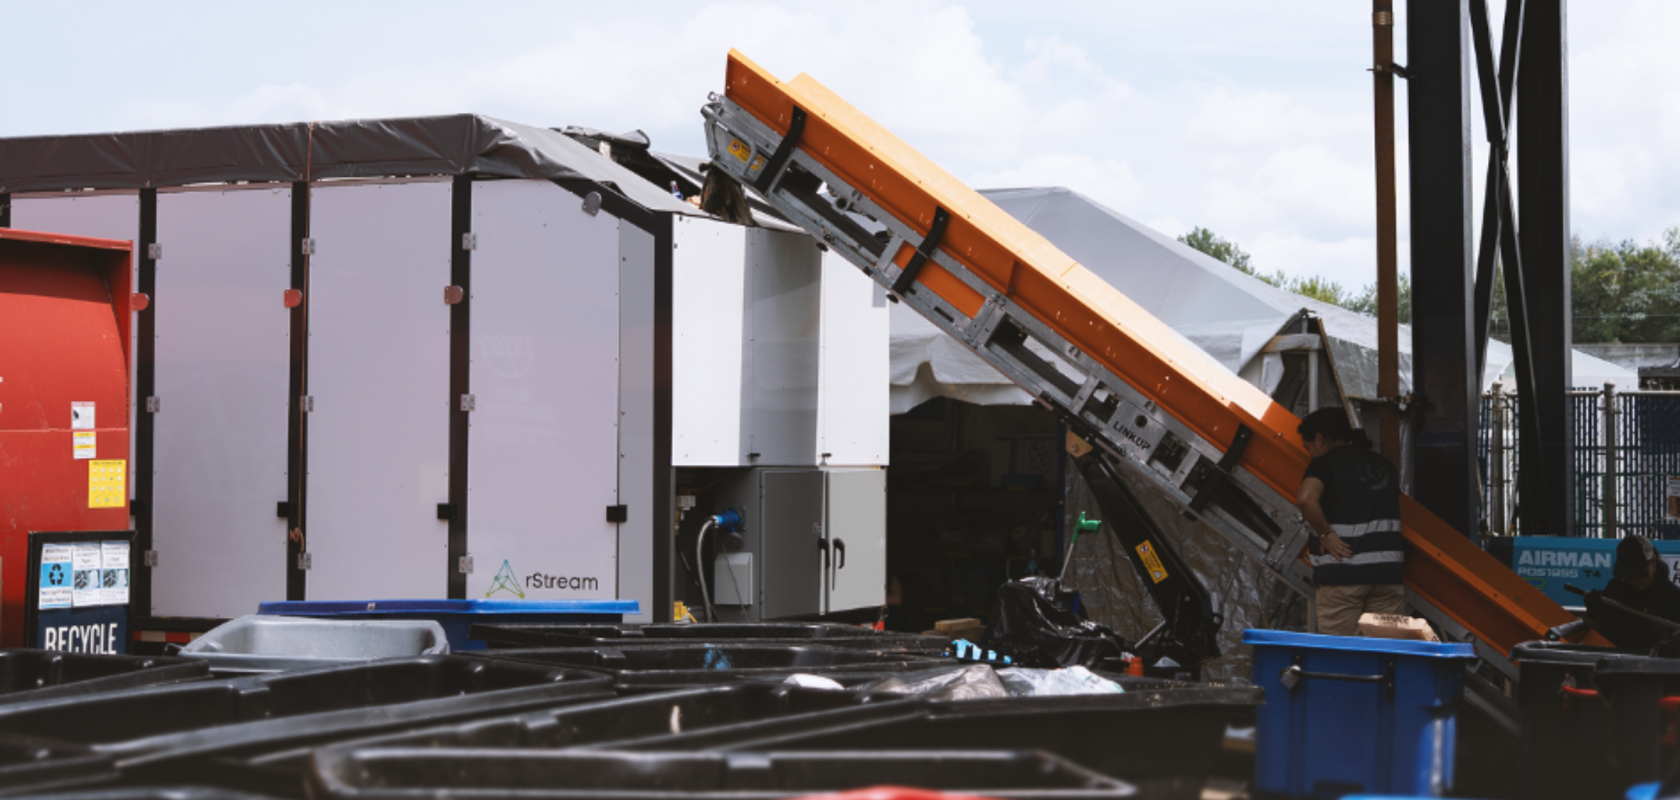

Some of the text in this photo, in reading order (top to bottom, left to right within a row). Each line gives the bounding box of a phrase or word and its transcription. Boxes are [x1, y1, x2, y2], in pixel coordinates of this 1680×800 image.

[1113, 420, 1151, 450] LINKUP
[1518, 550, 1611, 568] AIRMAN
[525, 572, 599, 591] rStream
[1583, 570, 1602, 578] T4
[45, 623, 118, 655] RECYCLE
